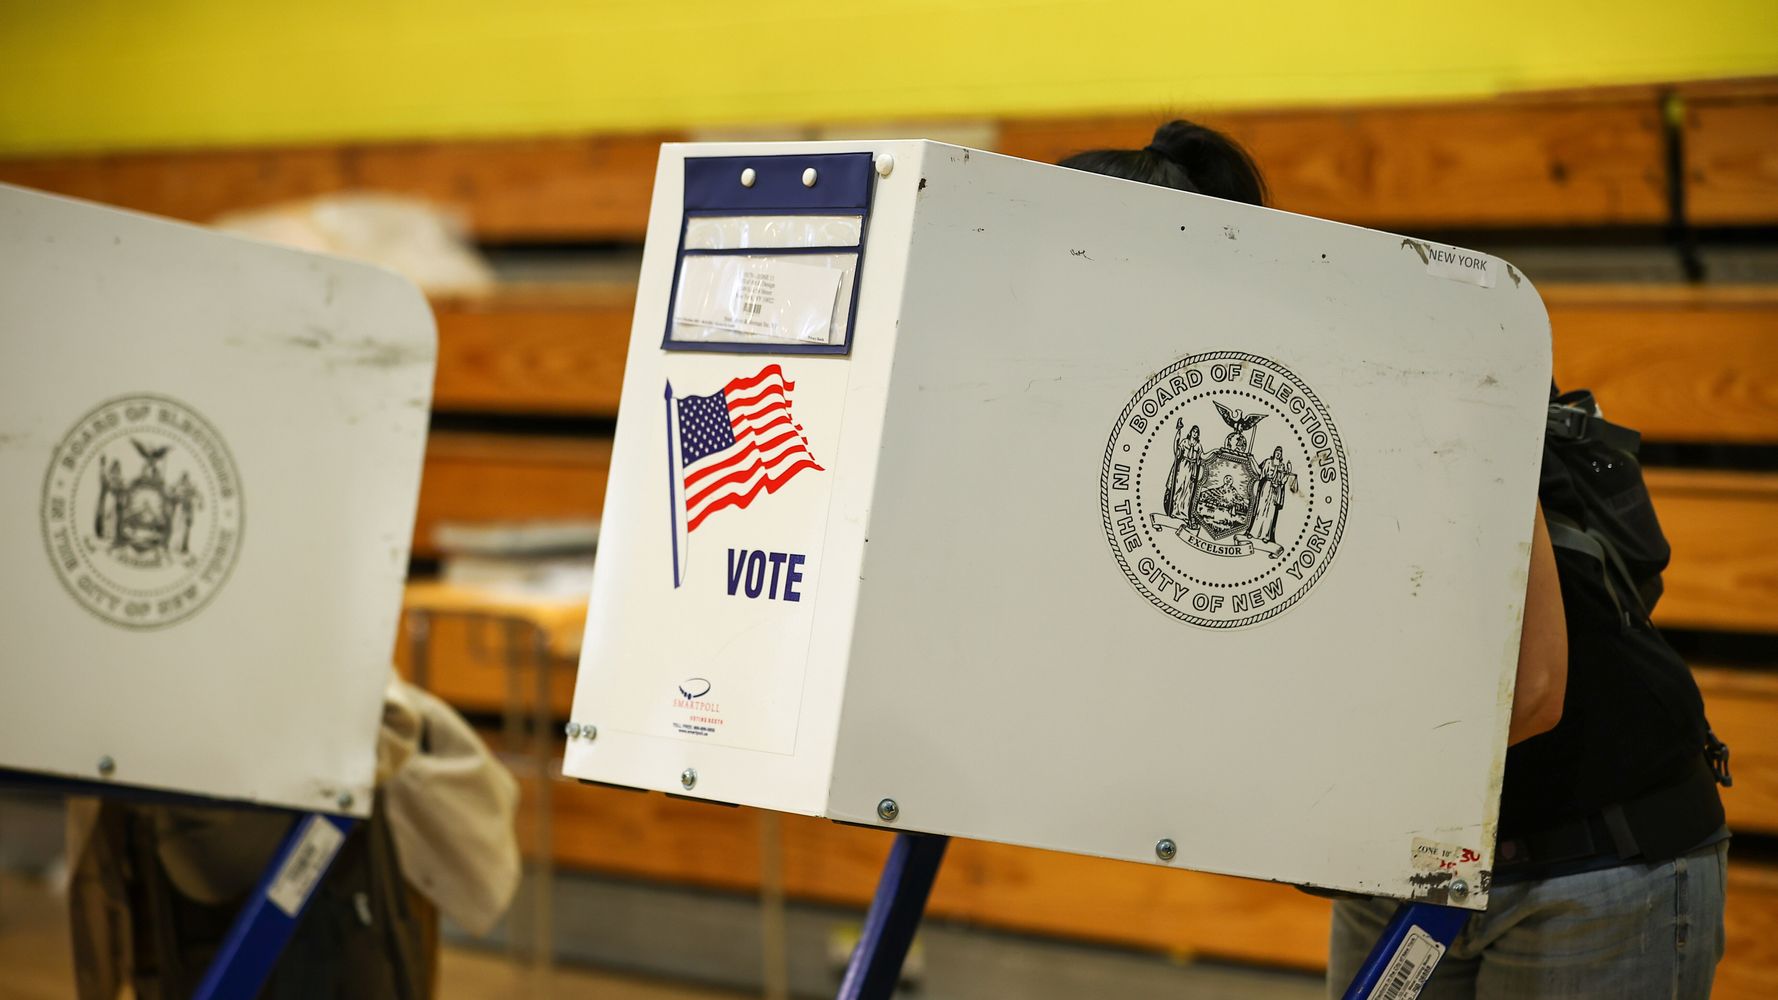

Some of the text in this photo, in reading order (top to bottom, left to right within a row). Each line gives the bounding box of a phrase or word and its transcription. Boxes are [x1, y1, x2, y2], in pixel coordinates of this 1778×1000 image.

[1429, 249, 1487, 271] NEW YORK
[1129, 364, 1337, 483] BOARD OF ELECTIONS
[1113, 464, 1333, 613] IN THE CITY OF NEW YORK
[1188, 536, 1242, 555] EXCELSIOR
[727, 548, 806, 602] VOTE
[673, 699, 721, 713] SMARTPOLL
